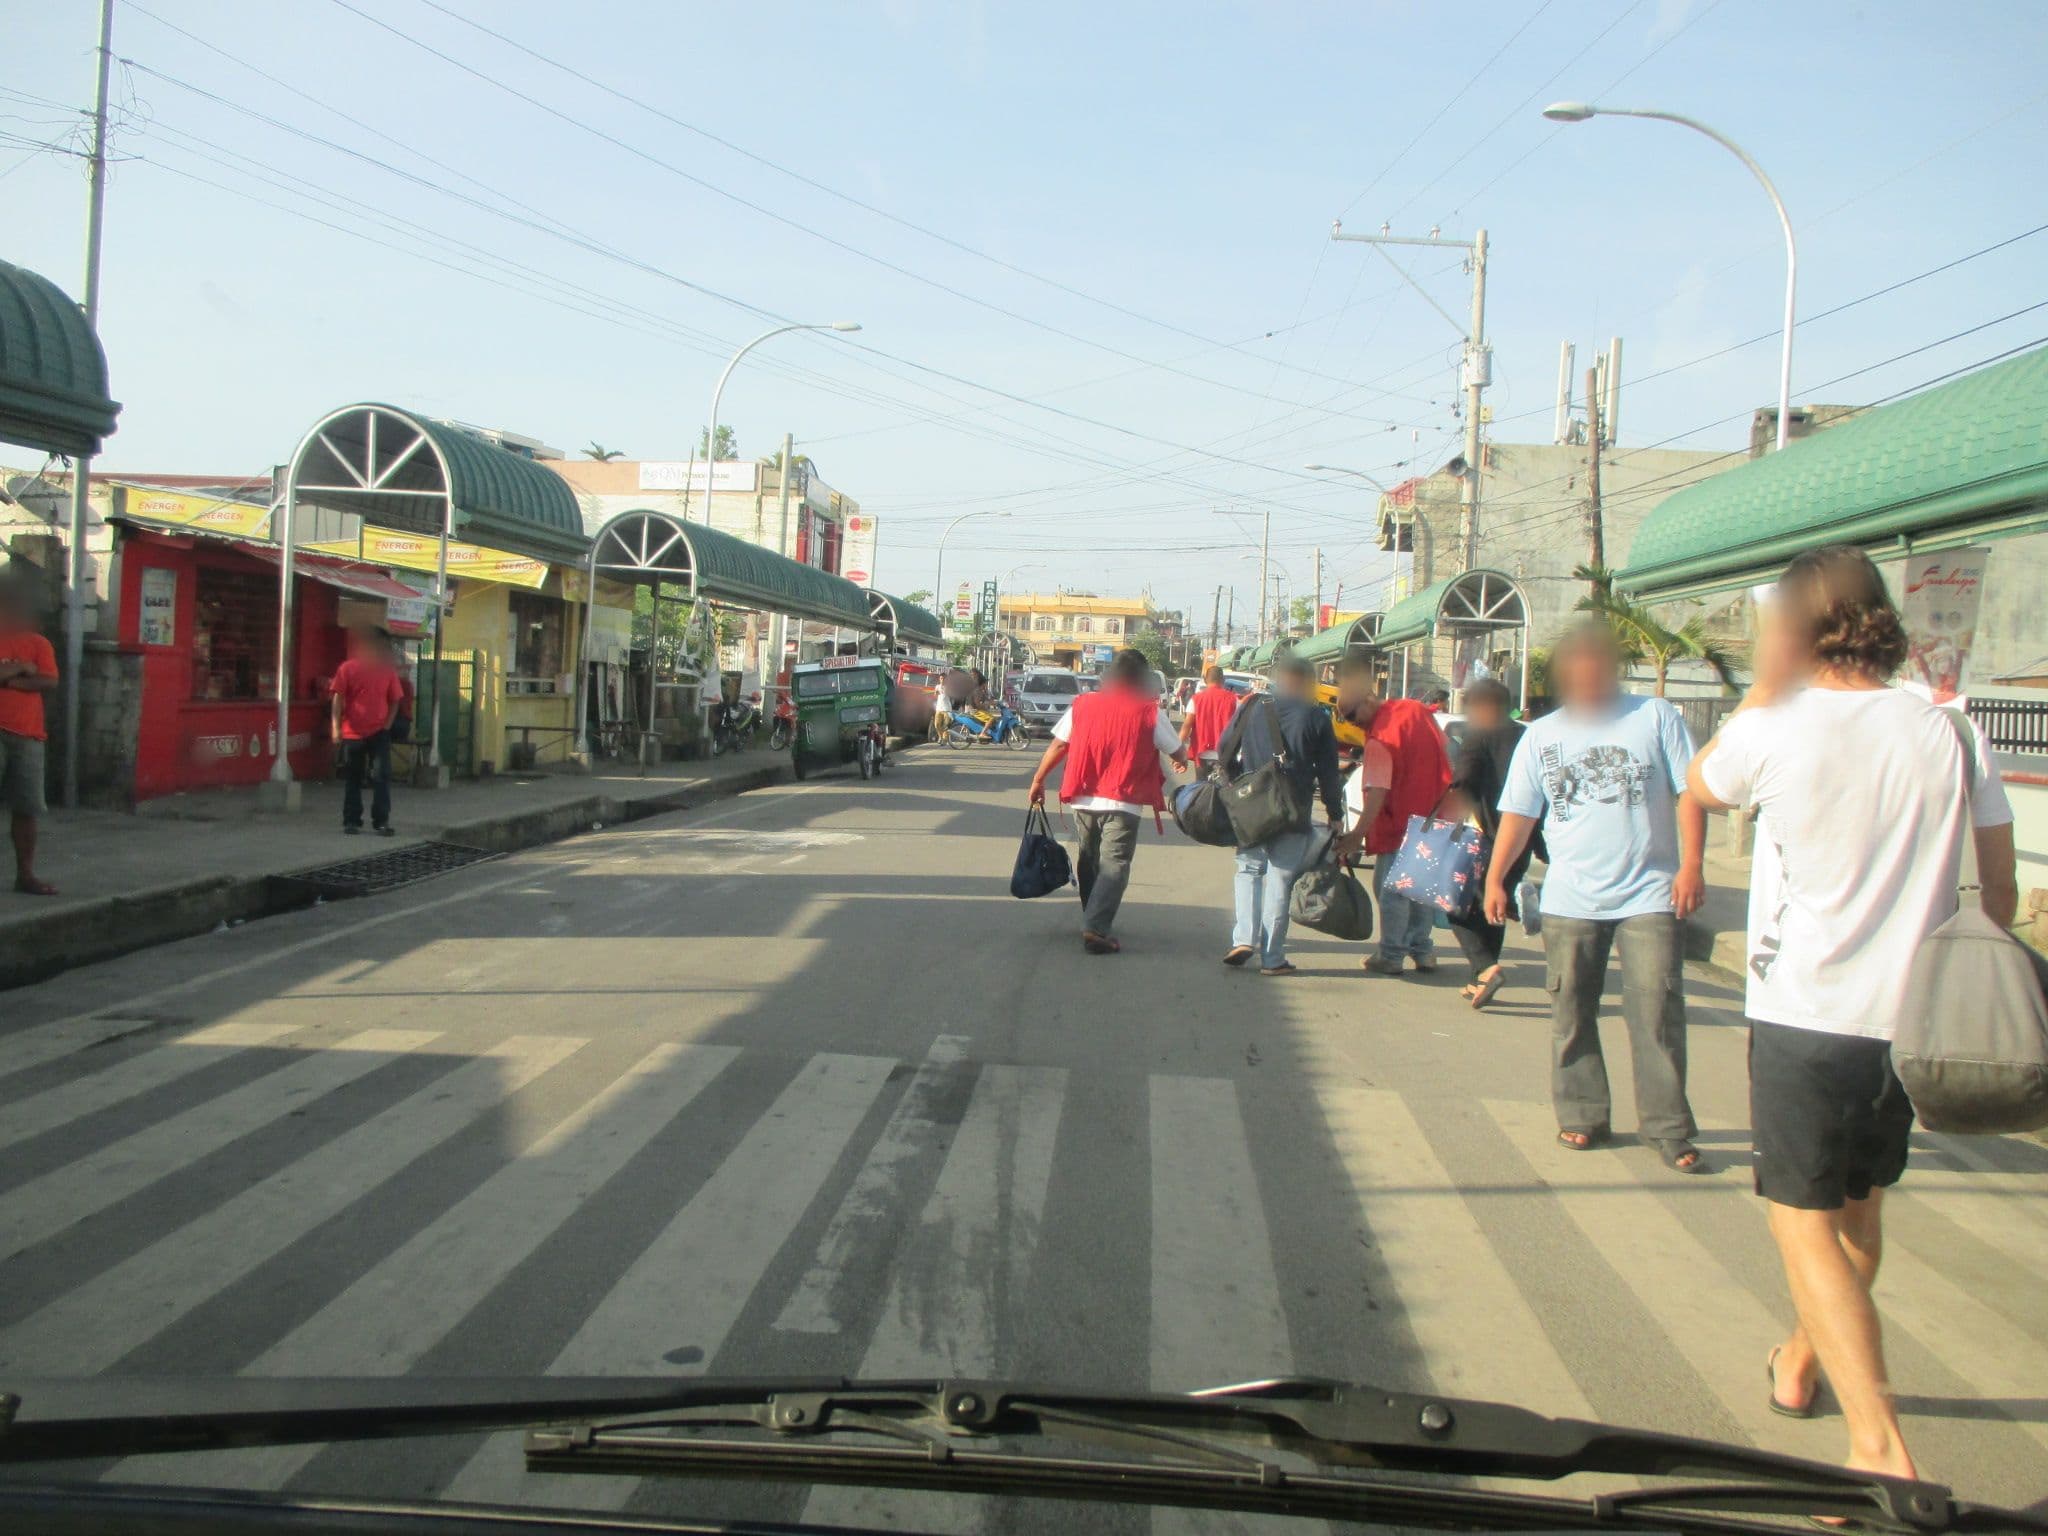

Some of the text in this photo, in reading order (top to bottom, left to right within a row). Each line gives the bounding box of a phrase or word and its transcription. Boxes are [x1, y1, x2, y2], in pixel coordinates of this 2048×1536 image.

[138, 501, 186, 511] ENERGEN
[375, 540, 424, 551] ENERGEN
[434, 551, 483, 561] EERGEN
[495, 561, 544, 571] ENERGEN
[824, 655, 858, 669] SPECIAL TRIP
